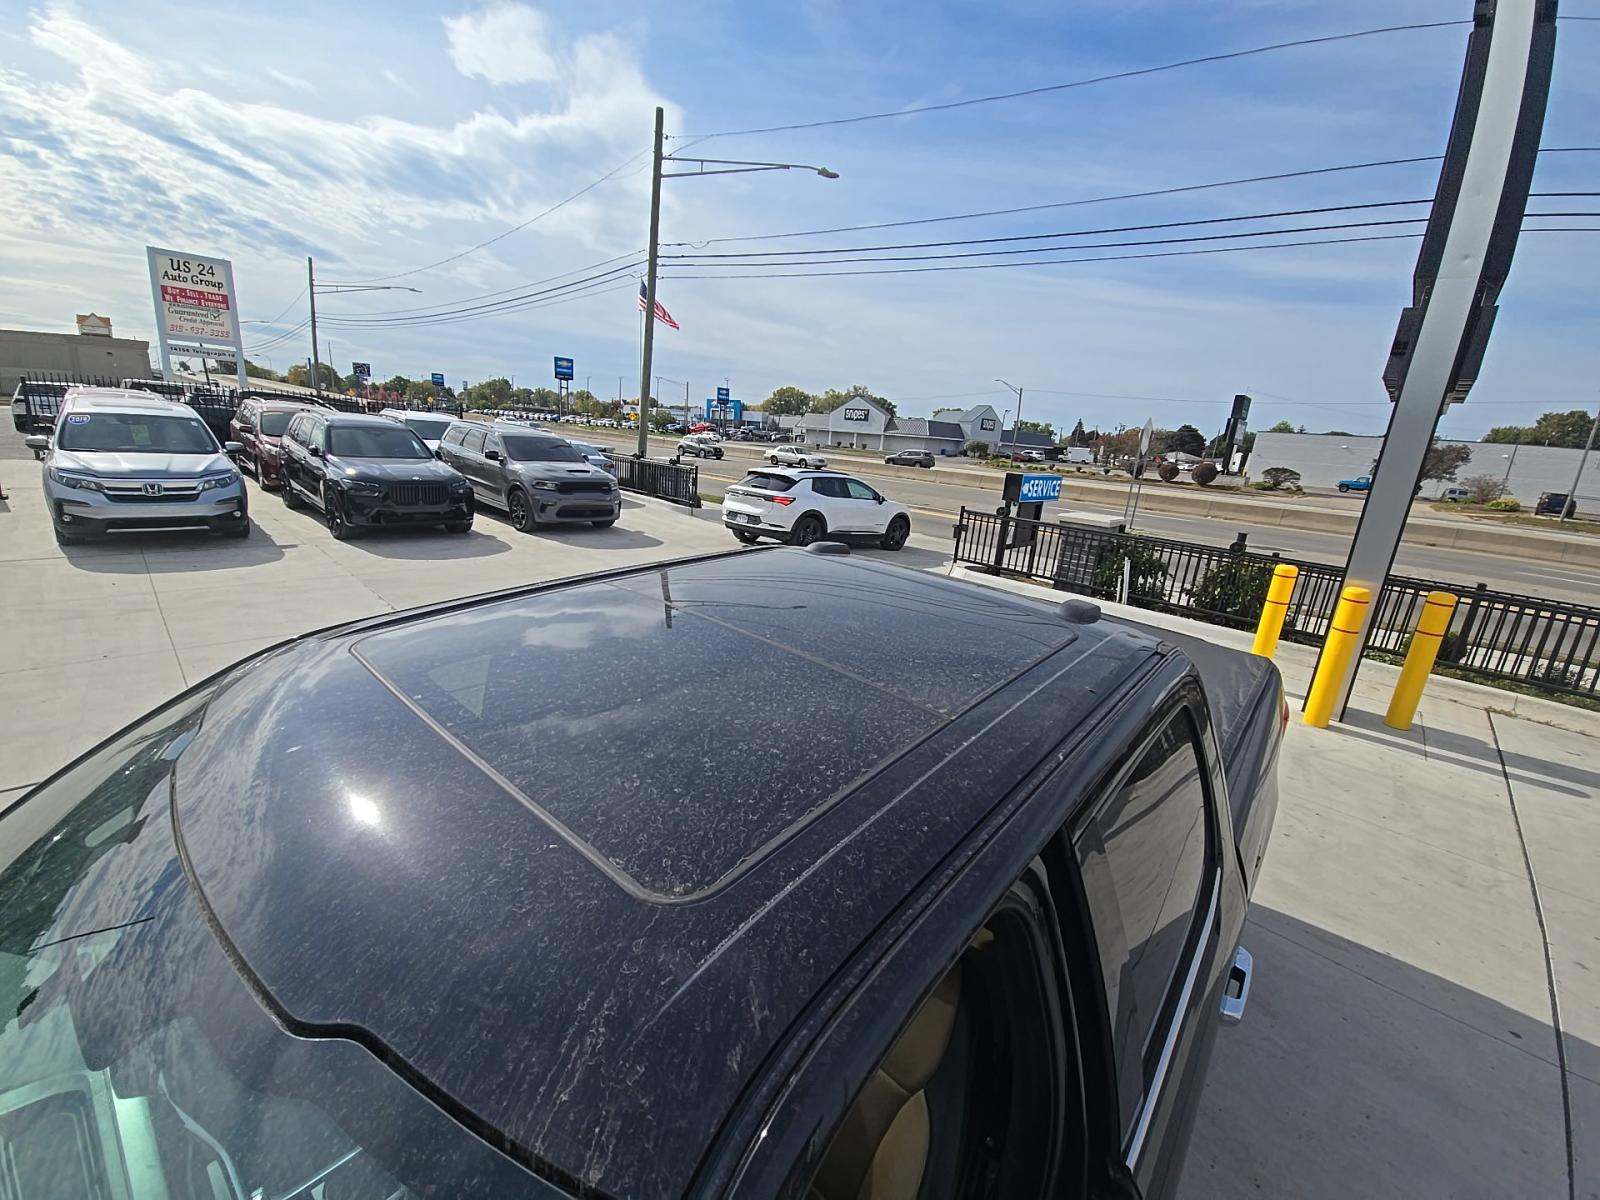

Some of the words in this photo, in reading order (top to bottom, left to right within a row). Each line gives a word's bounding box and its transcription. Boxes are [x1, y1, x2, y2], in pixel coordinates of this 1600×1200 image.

[169, 258, 191, 273] US
[197, 263, 216, 277] 24
[162, 270, 188, 283] Auto
[191, 275, 224, 291] Group
[168, 306, 209, 318] Guaranteed
[192, 348, 227, 357] Telegraph
[1028, 479, 1061, 497] SERVICE
